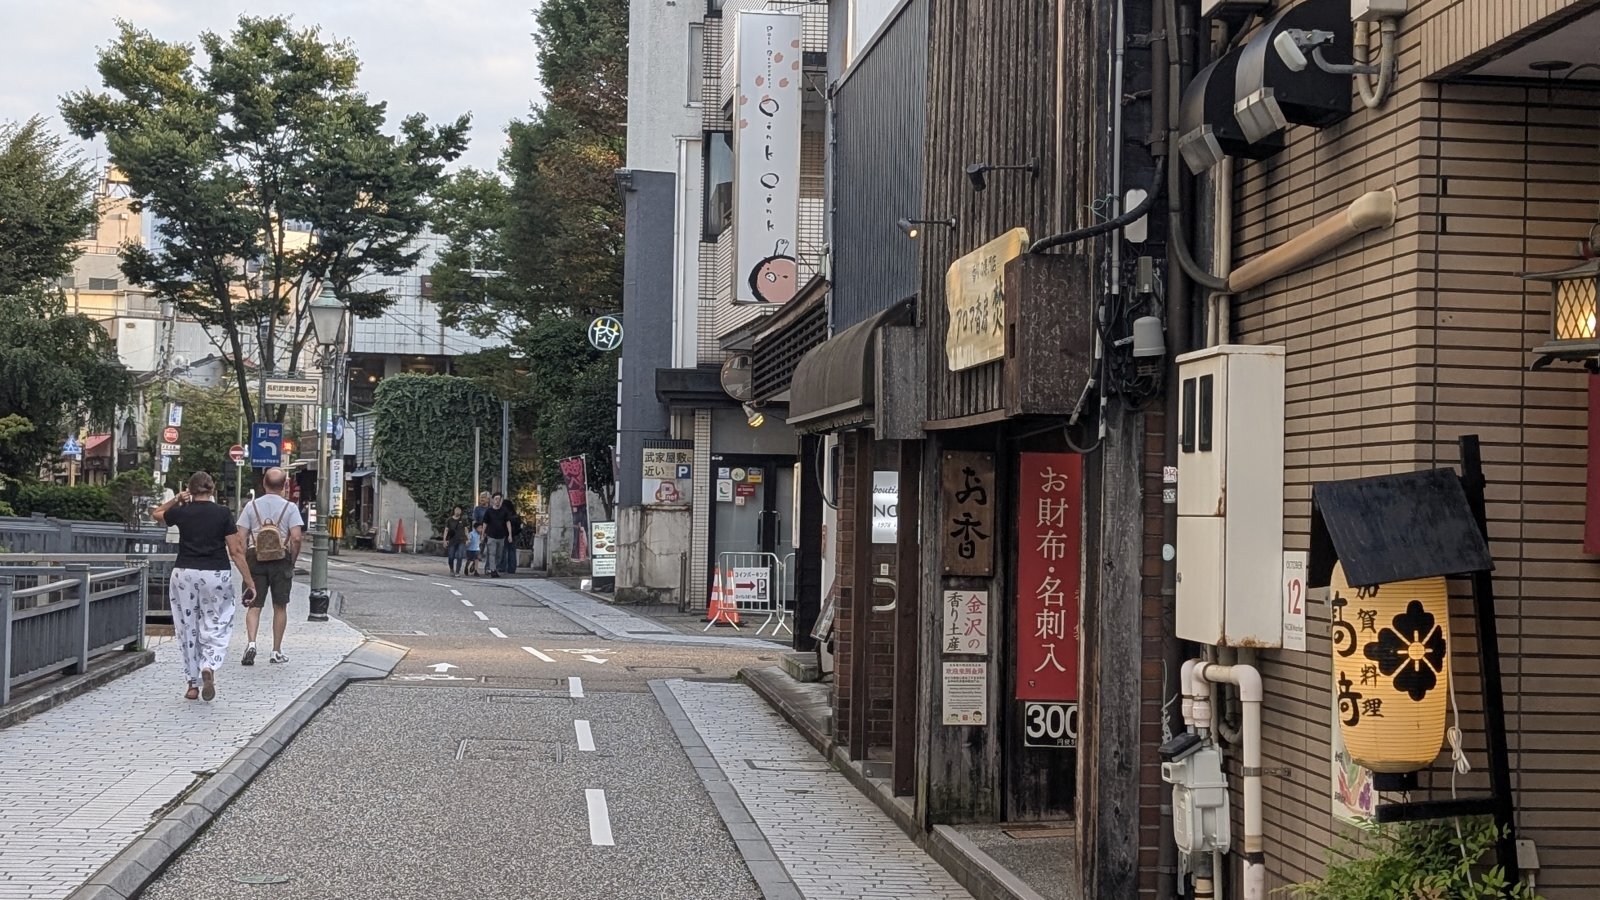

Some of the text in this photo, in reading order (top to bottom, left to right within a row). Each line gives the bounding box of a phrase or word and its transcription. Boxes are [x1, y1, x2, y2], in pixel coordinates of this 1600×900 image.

[758, 98, 780, 232] Oink Oink
[258, 427, 266, 438] P
[644, 465, 665, 477] 近い
[678, 466, 689, 478] P
[950, 466, 990, 560] お香
[1034, 466, 1069, 673] お財布・名刺入
[1287, 578, 1302, 615] 12
[946, 592, 963, 652] 香り土産
[964, 594, 986, 650] 金沢の
